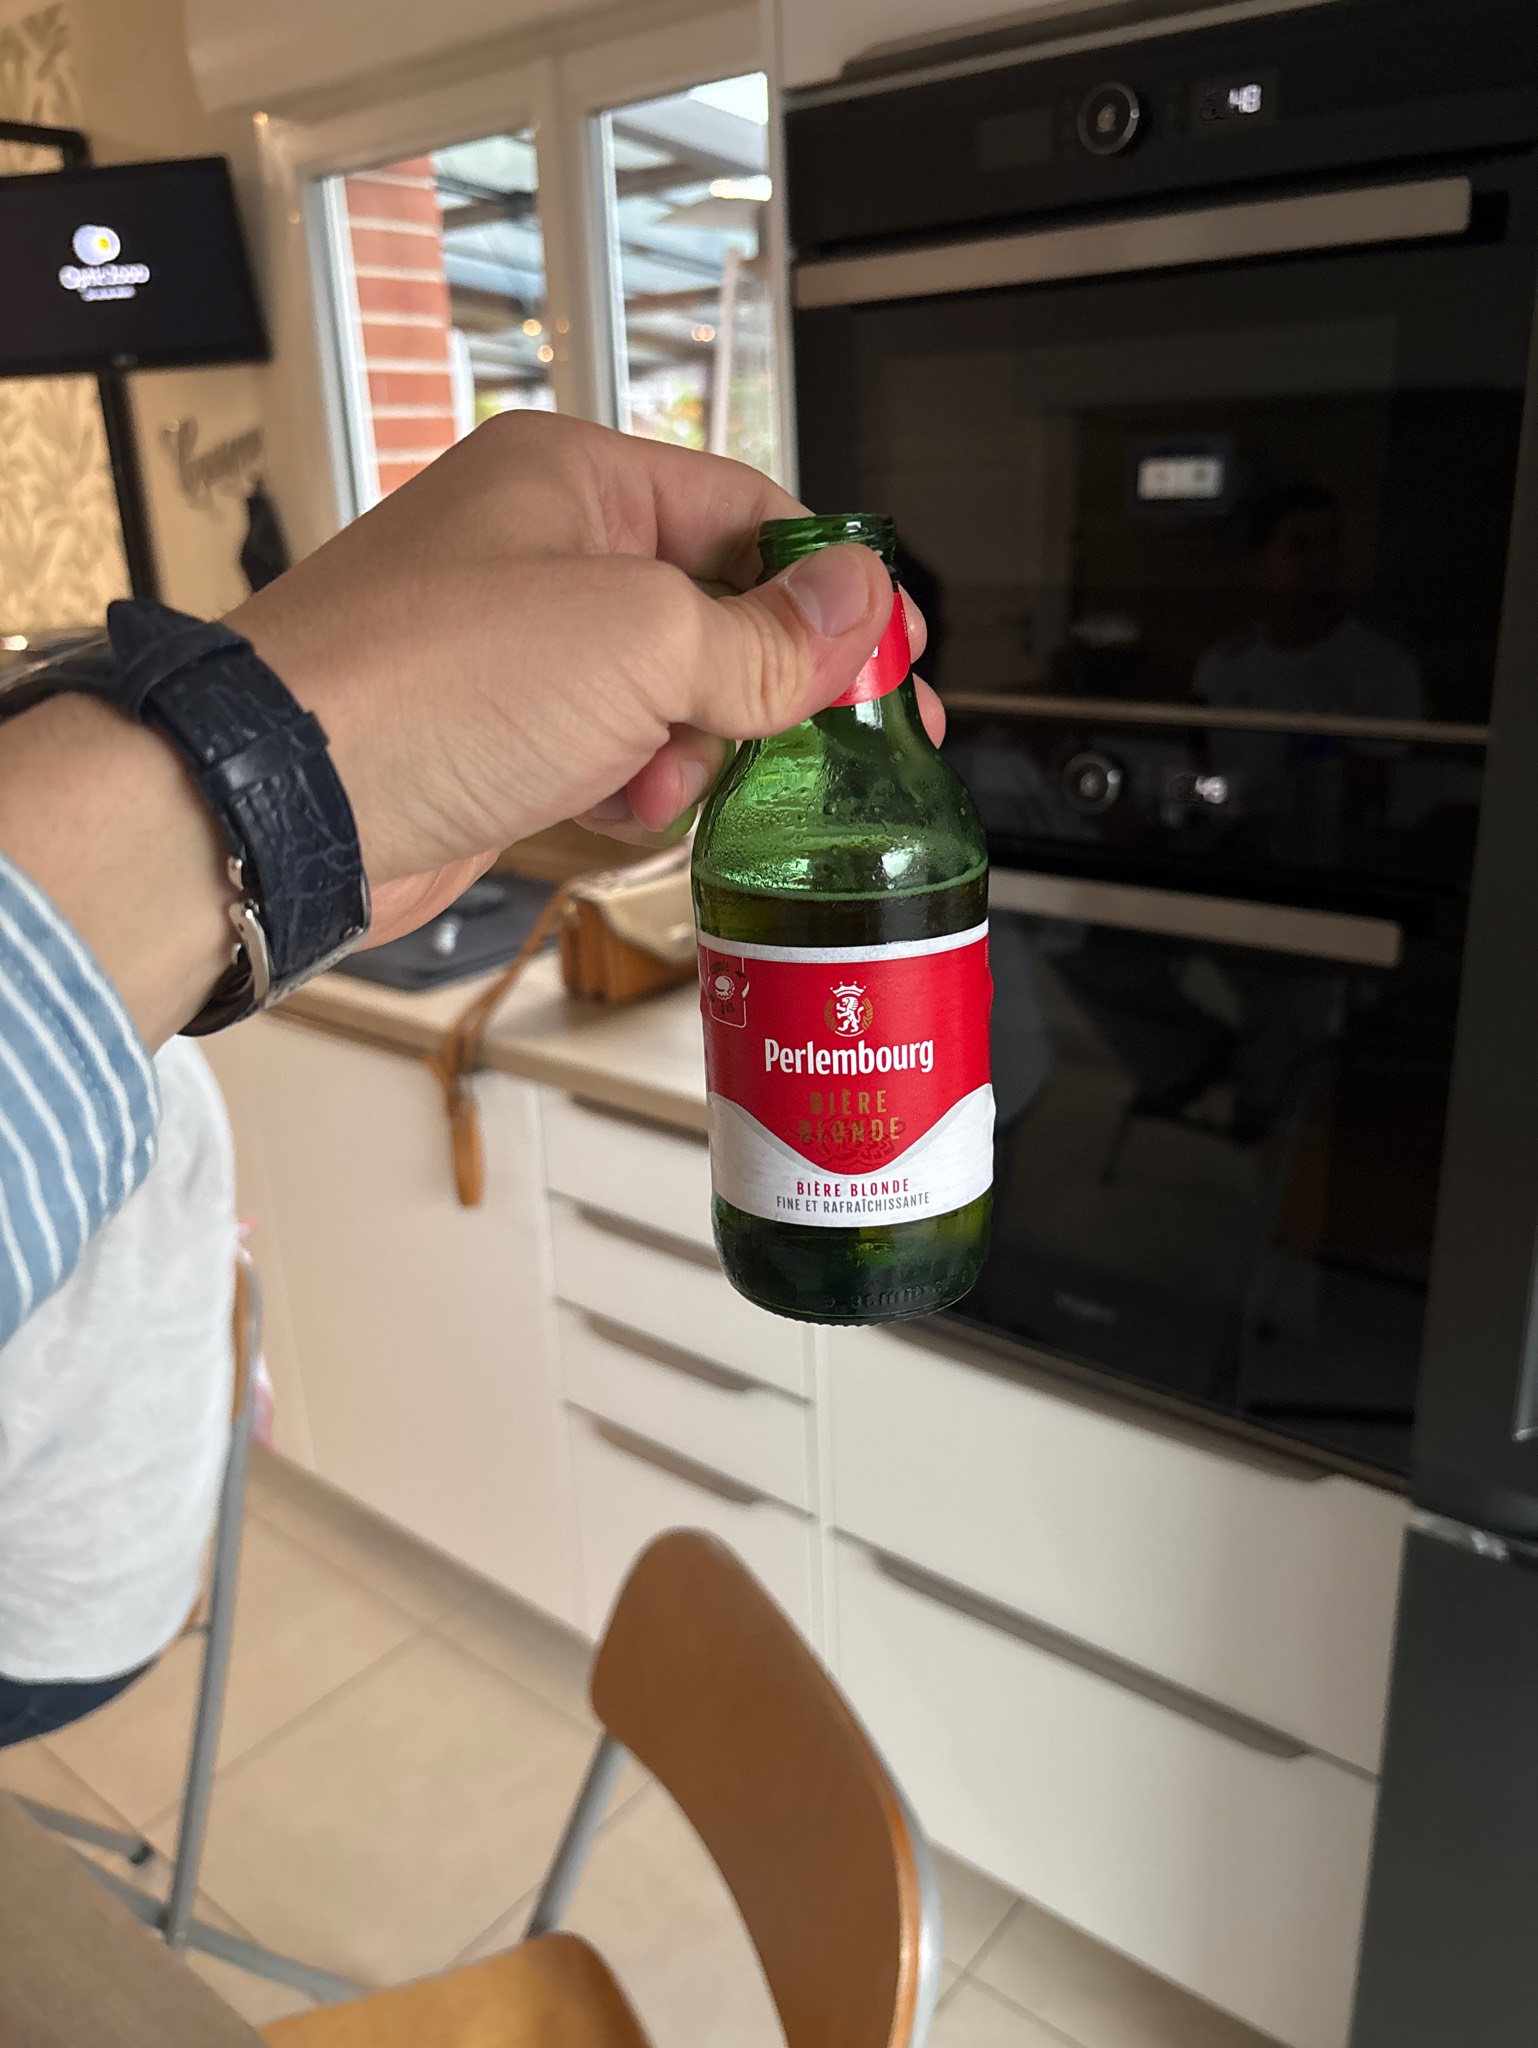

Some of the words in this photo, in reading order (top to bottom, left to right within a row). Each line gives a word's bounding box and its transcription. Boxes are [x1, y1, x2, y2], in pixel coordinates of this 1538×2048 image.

[764, 1038, 934, 1076] Perlembourg
[810, 1088, 887, 1115] BIÈRE
[800, 1116, 901, 1144] BLONDE
[796, 1180, 841, 1197] BIÈRE
[850, 1178, 909, 1197] BLONDE
[776, 1195, 801, 1211] FINE
[805, 1199, 818, 1213] ET
[823, 1191, 930, 1214] RAFRAÎCHISSANTE
